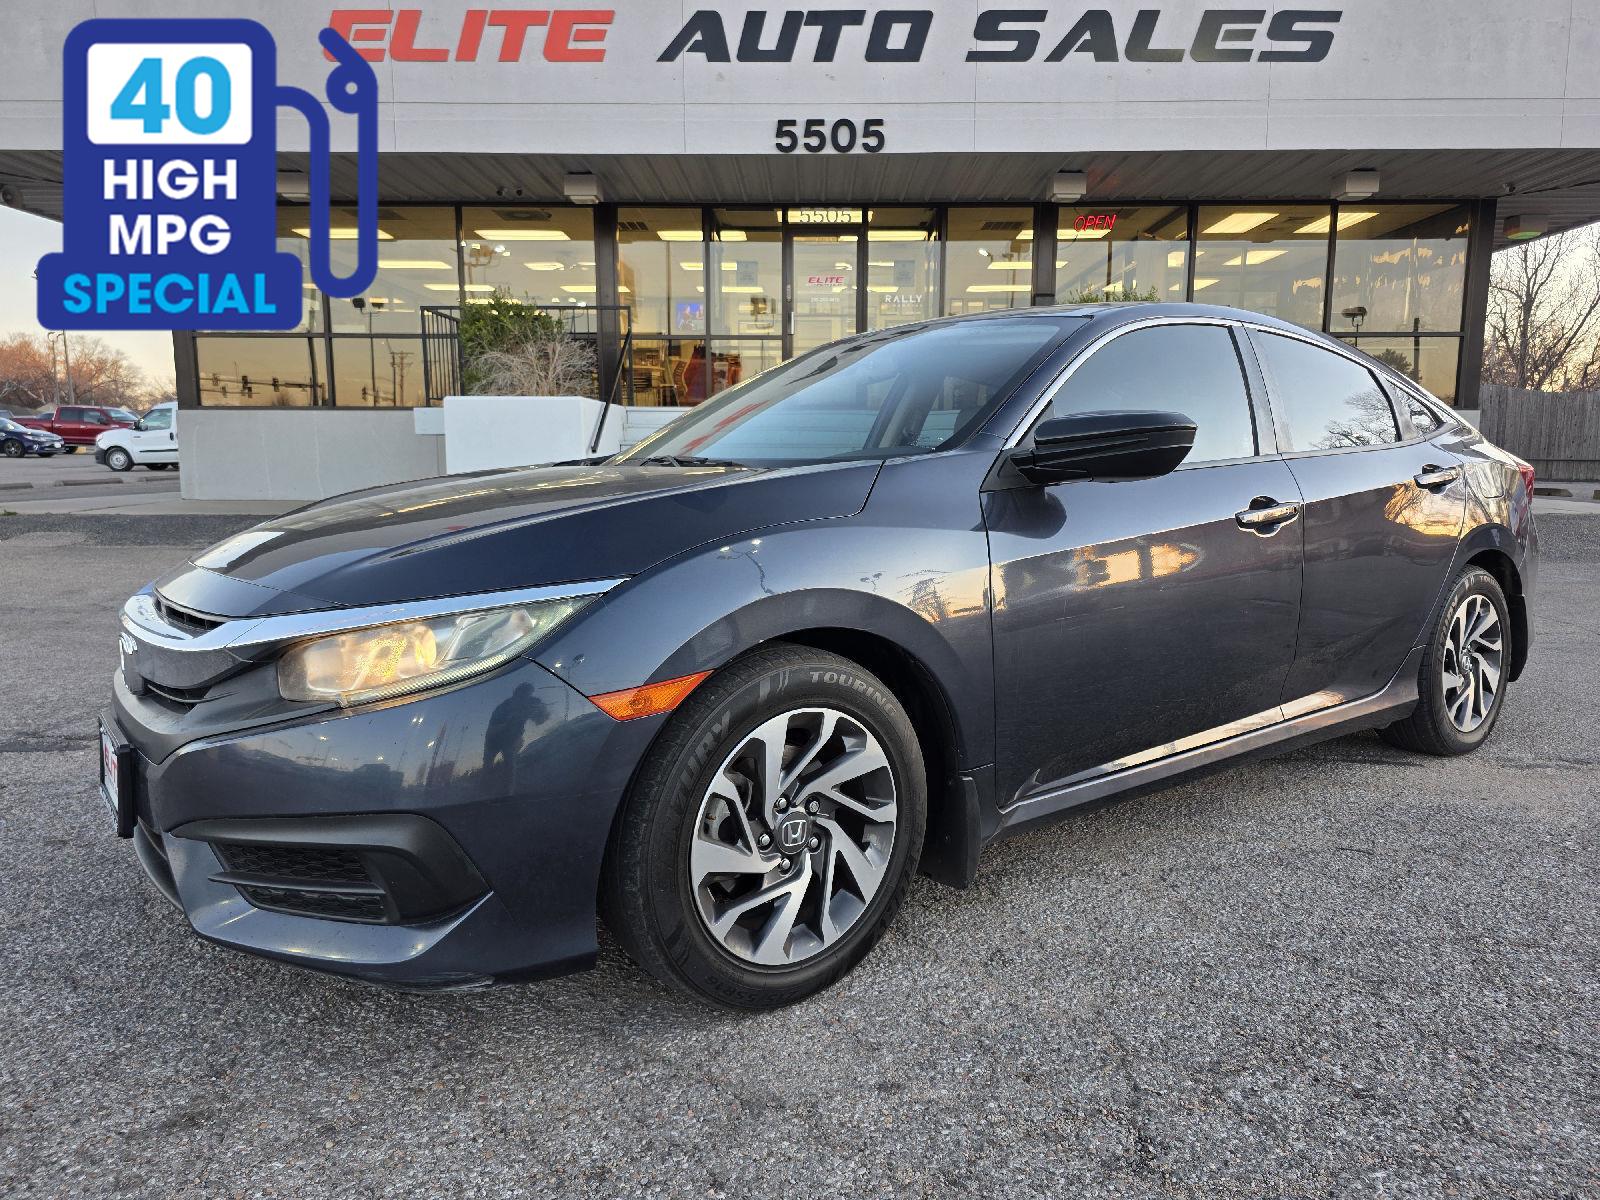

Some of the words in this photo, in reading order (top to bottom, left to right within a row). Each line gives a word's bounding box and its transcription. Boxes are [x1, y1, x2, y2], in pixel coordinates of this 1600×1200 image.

[323, 10, 615, 62] ELITE
[657, 10, 934, 62] AUTO
[965, 10, 1342, 62] SALES
[775, 119, 885, 153] 5505
[800, 207, 852, 223] 5505
[1074, 214, 1117, 231] OPEN
[885, 294, 922, 303] RALLY
[809, 671, 897, 716] TOURING
